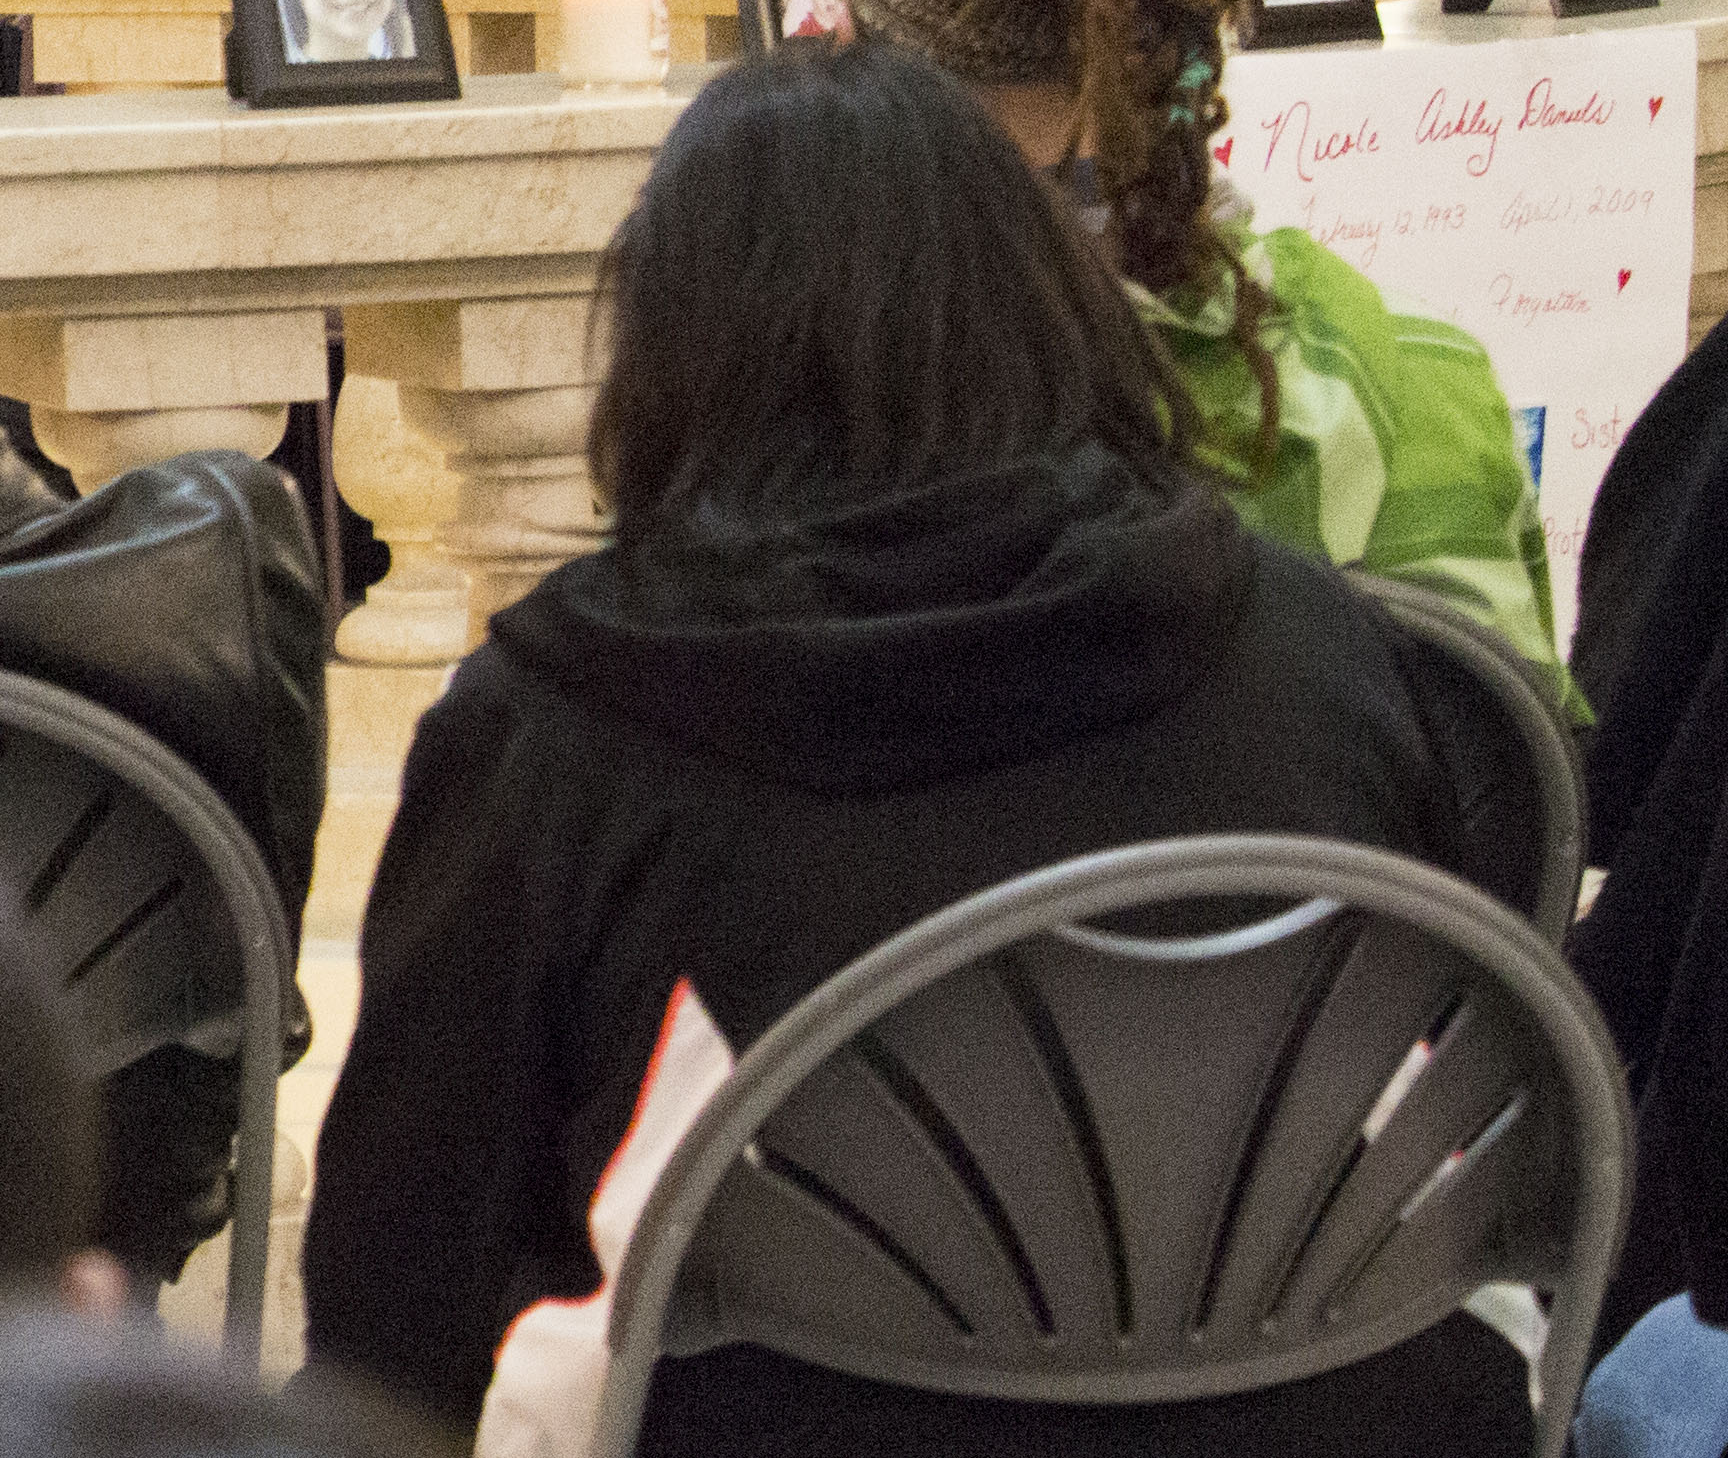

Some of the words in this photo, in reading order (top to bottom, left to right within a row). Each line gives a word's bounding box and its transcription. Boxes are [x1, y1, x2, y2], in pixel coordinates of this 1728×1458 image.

[1260, 99, 1382, 183] Nicole
[1414, 86, 1504, 177] Ashley
[1517, 75, 1617, 132] Daniels
[1587, 184, 1656, 217] 2009
[1570, 403, 1624, 451] Sist
